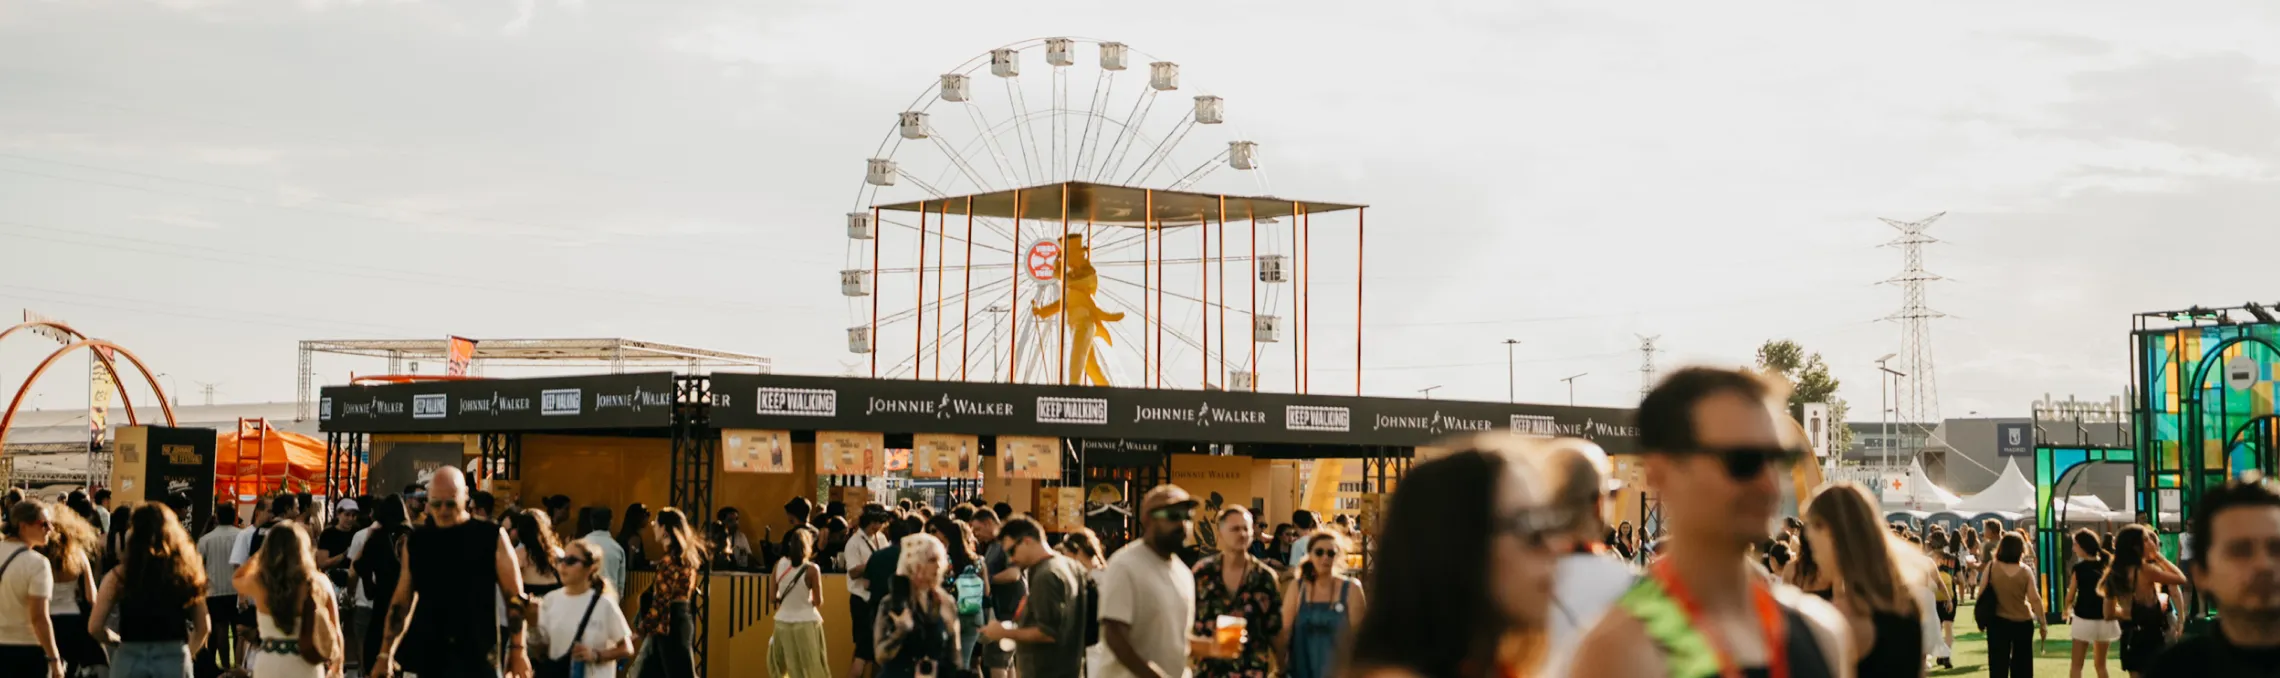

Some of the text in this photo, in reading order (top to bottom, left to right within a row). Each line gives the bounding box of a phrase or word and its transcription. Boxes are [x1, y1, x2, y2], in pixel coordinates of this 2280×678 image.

[342, 400, 404, 417] JOHNNIE WALKER
[459, 396, 530, 415] JOHNNIE WALKER
[595, 393, 632, 411] JOHNNIE
[761, 392, 833, 412] KEEP WALKING
[865, 396, 1014, 416] JOHNNIE WALKER
[1040, 401, 1105, 420] KEEP WALKING
[1134, 405, 1266, 423] JOHNNIE WALKER
[1290, 409, 1347, 427] KEEP WALKING
[1373, 413, 1492, 431] JOHNNIE WALKER
[1513, 418, 1531, 433] KEEP
[1595, 422, 1641, 437] WALKER
[1083, 441, 1158, 451] OHNNIE WALKER
